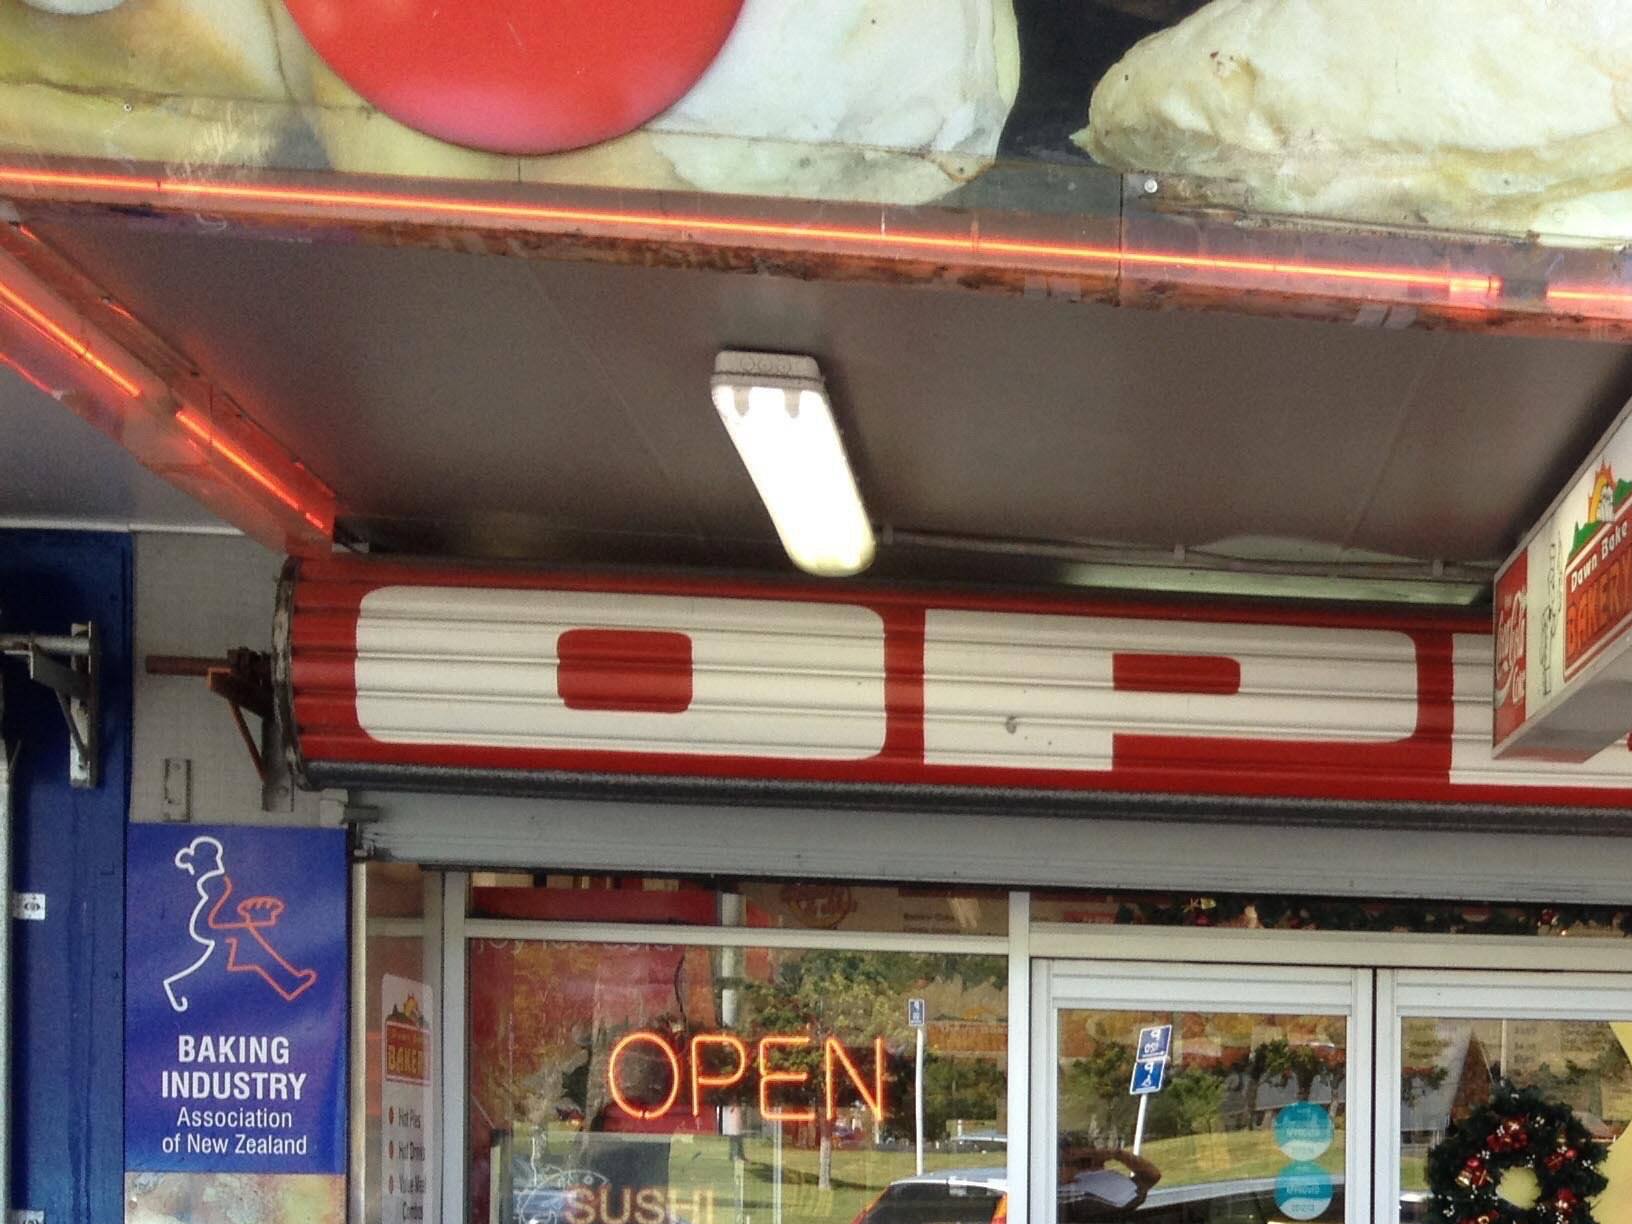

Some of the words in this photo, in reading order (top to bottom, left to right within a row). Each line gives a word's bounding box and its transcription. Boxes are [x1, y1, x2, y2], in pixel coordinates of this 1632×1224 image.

[1571, 552, 1598, 592] Dawn
[1602, 520, 1628, 560] Bake
[178, 1035, 290, 1064] BAKING
[161, 1072, 307, 1100] INDUSTRY
[608, 1031, 886, 1122] OPEN
[177, 1106, 292, 1129] Association
[162, 1132, 181, 1154] of
[187, 1134, 229, 1155] New
[235, 1134, 307, 1156] Zealand
